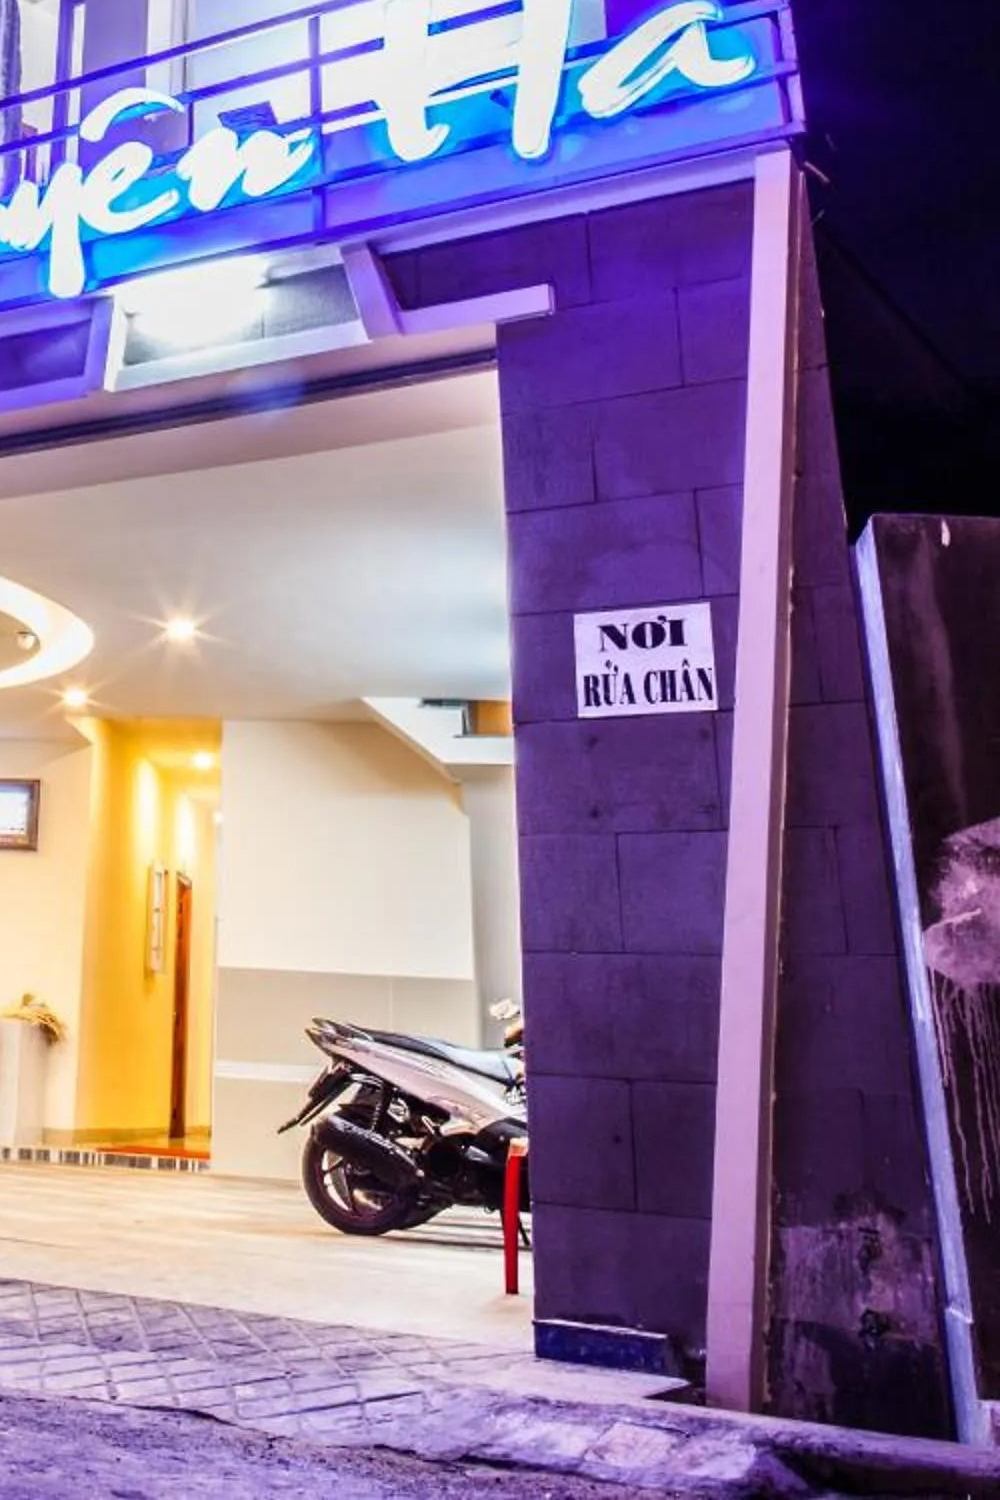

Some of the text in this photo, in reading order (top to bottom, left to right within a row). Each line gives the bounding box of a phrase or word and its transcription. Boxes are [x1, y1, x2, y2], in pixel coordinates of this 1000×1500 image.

[598, 614, 689, 652] NƠI
[583, 657, 714, 708] RỬA CHÂN
